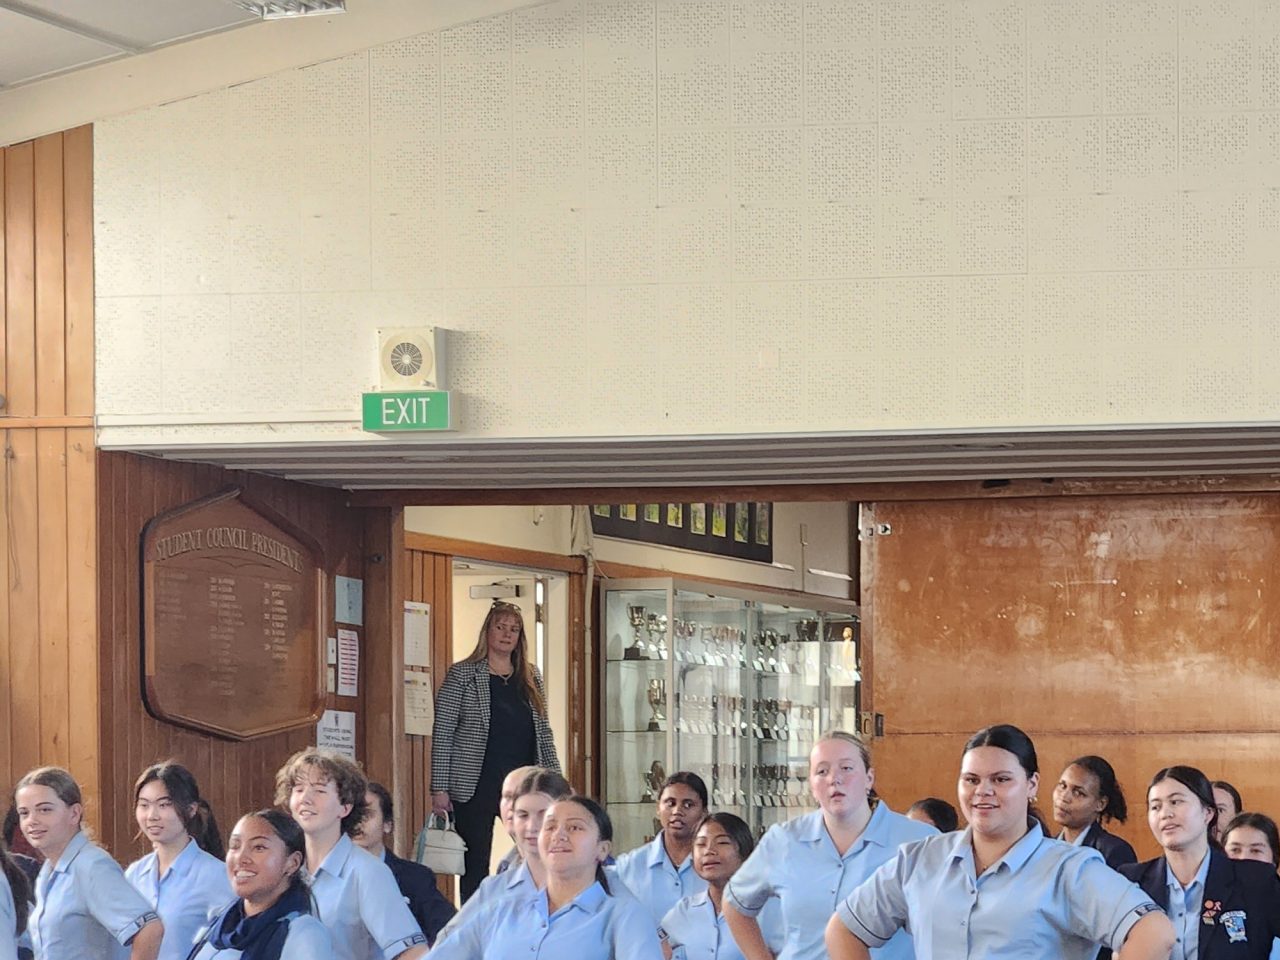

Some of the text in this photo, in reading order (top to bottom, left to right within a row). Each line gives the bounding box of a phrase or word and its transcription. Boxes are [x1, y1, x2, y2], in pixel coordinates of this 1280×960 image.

[382, 397, 431, 425] EXIT
[156, 527, 305, 573] STUDENT COUNCIL PRESIDENTS
